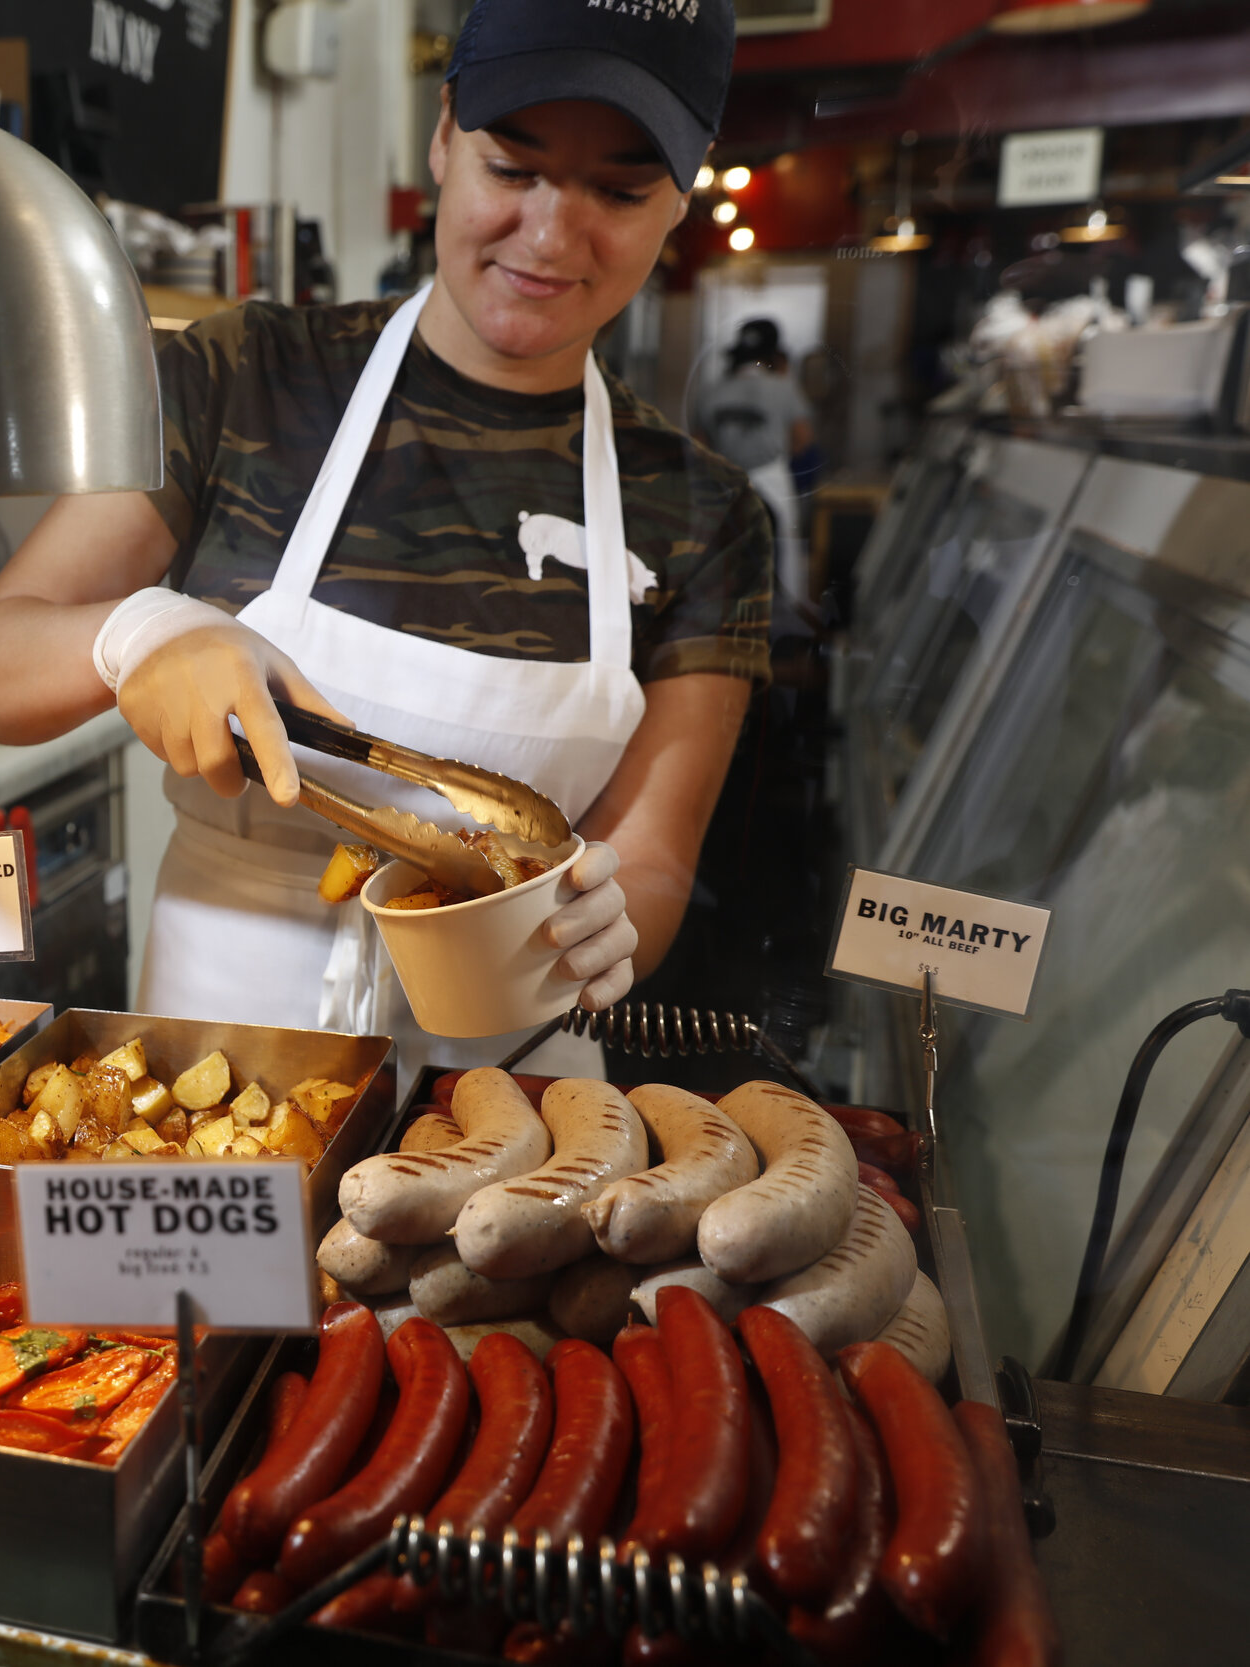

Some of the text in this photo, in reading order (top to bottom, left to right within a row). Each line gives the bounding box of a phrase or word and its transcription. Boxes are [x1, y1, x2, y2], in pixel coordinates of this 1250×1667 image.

[857, 898, 1032, 953] BIG MARTY
[922, 935, 944, 947] ALL
[948, 941, 980, 954] BEEF
[47, 1176, 273, 1200] HOUSE-MADE
[46, 1204, 279, 1235] HOT DOGS
